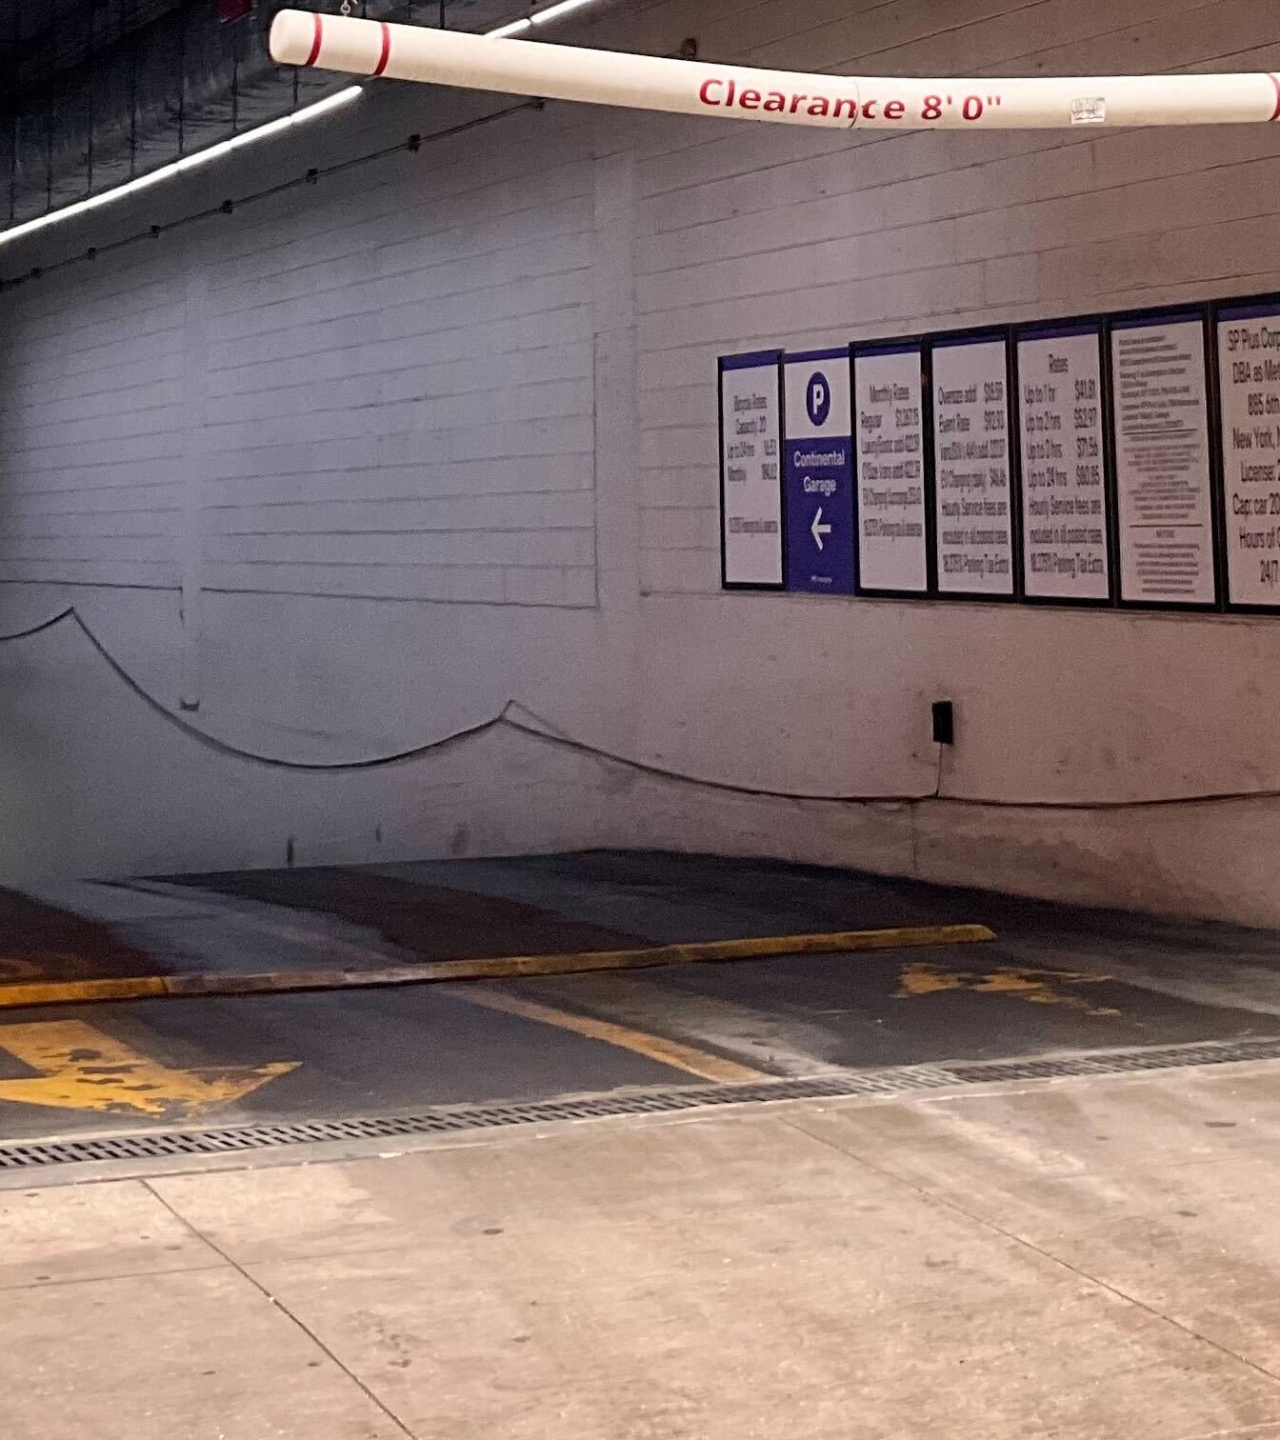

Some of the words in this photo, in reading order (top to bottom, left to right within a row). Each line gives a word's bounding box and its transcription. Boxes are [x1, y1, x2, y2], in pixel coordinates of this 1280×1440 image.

[698, 77, 906, 124] Clearance
[1228, 330, 1239, 351] SP
[1242, 329, 1259, 350] Plus
[1233, 362, 1251, 384] DBA
[1253, 364, 1263, 382] as
[813, 384, 824, 414] P
[1232, 428, 1252, 450] New
[1253, 427, 1274, 451] York,
[793, 449, 845, 467] Continental
[803, 476, 837, 498] Garage
[1239, 527, 1265, 549] Hours
[1267, 527, 1275, 548] of
[1260, 560, 1278, 587] 24/7
